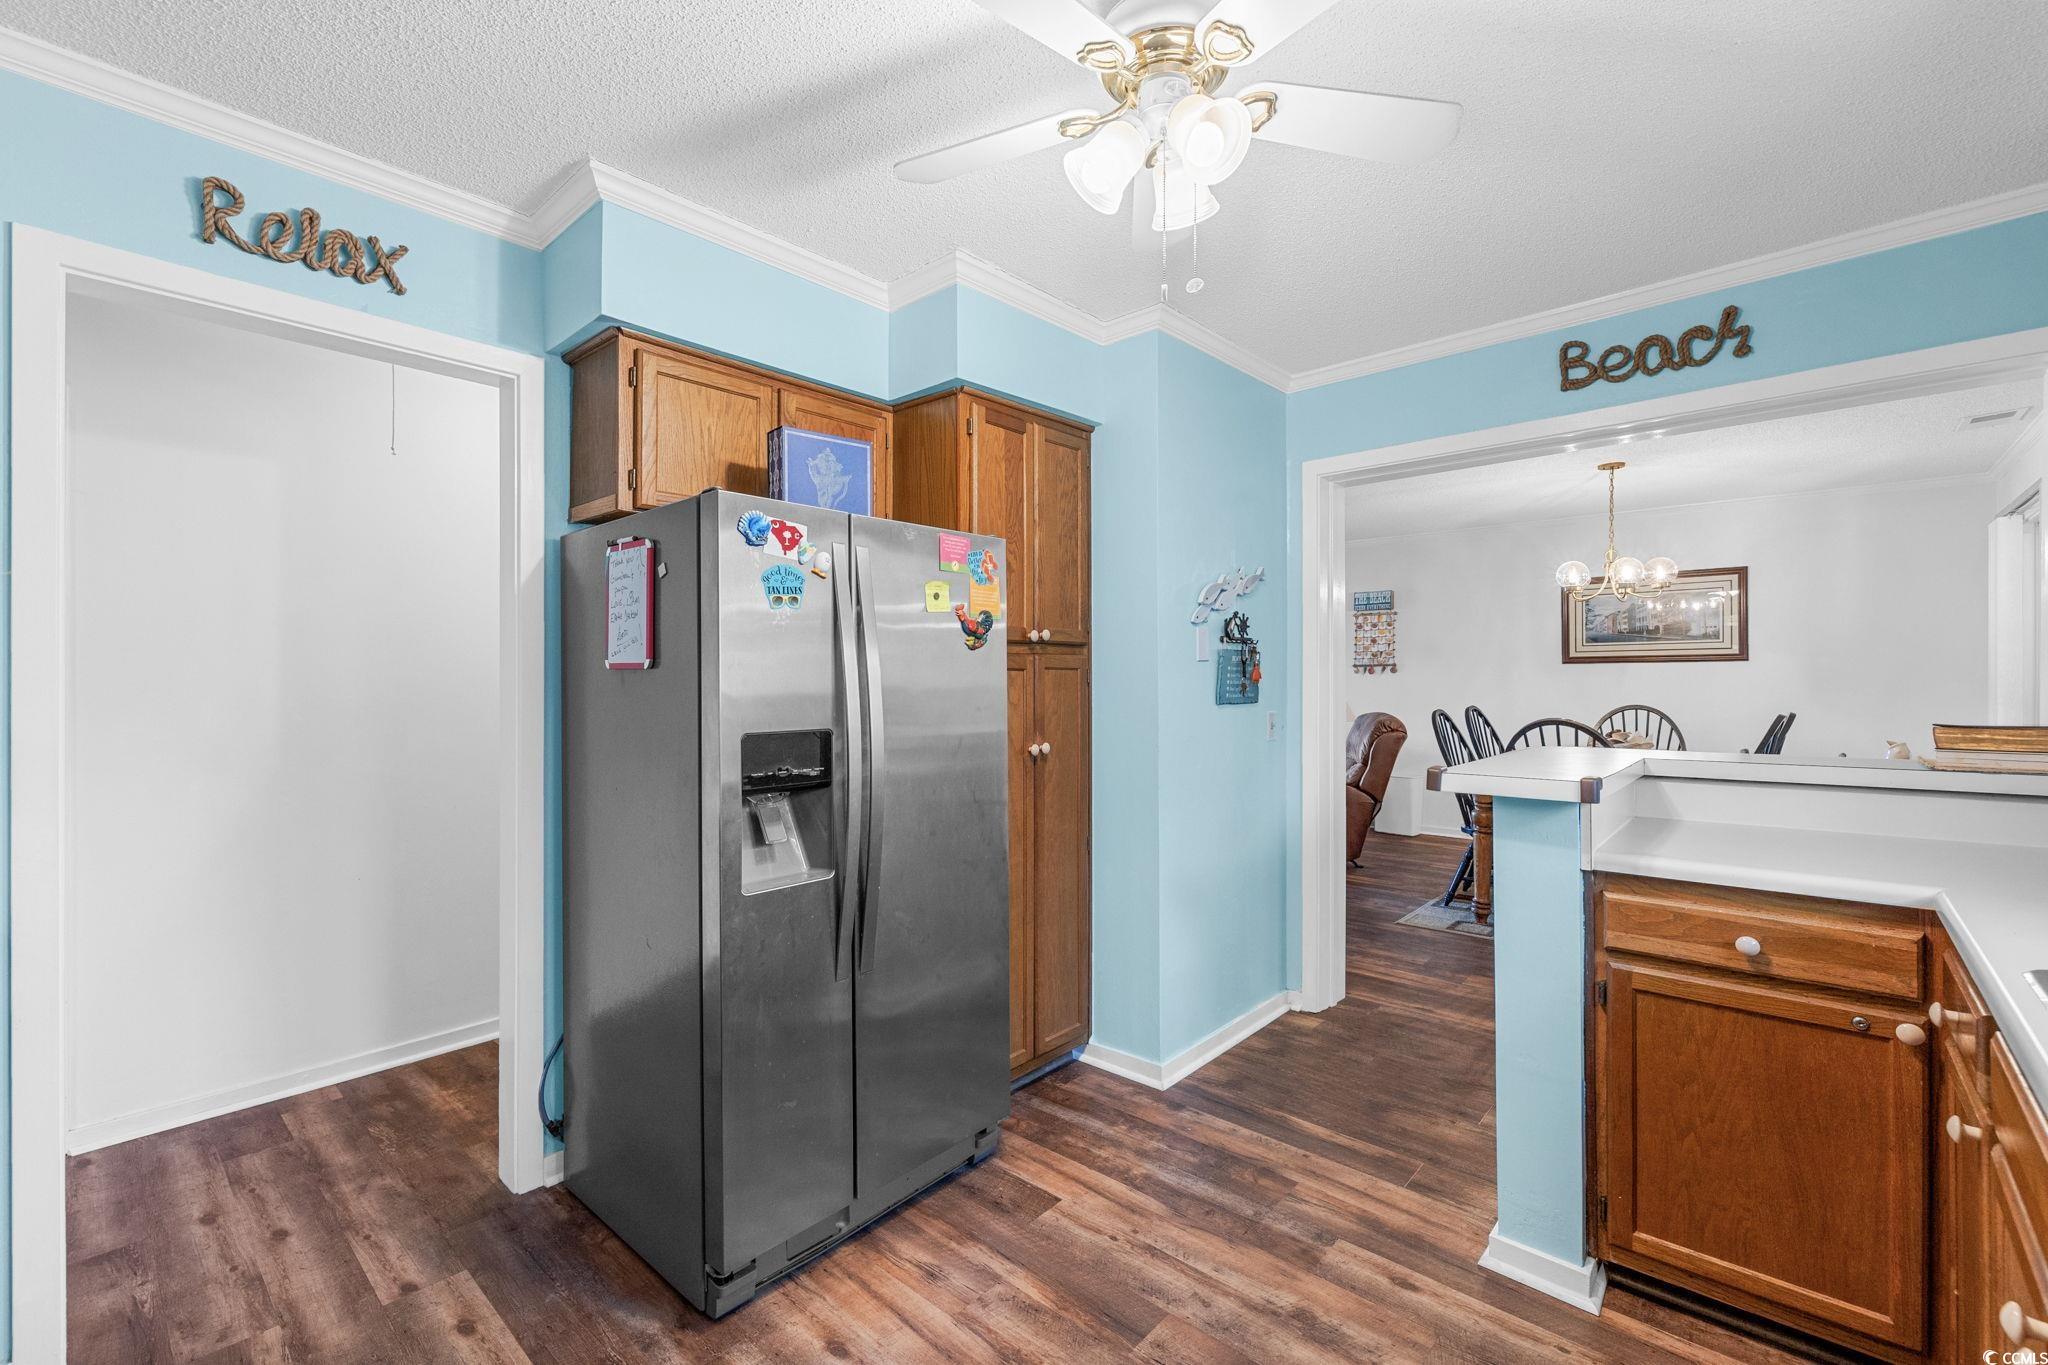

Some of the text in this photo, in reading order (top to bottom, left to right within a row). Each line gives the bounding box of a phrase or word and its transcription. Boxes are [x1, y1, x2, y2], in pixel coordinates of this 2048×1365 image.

[202, 176, 409, 296] Relax
[1559, 305, 1753, 392] Beach
[767, 586, 803, 595] TAN LINES
